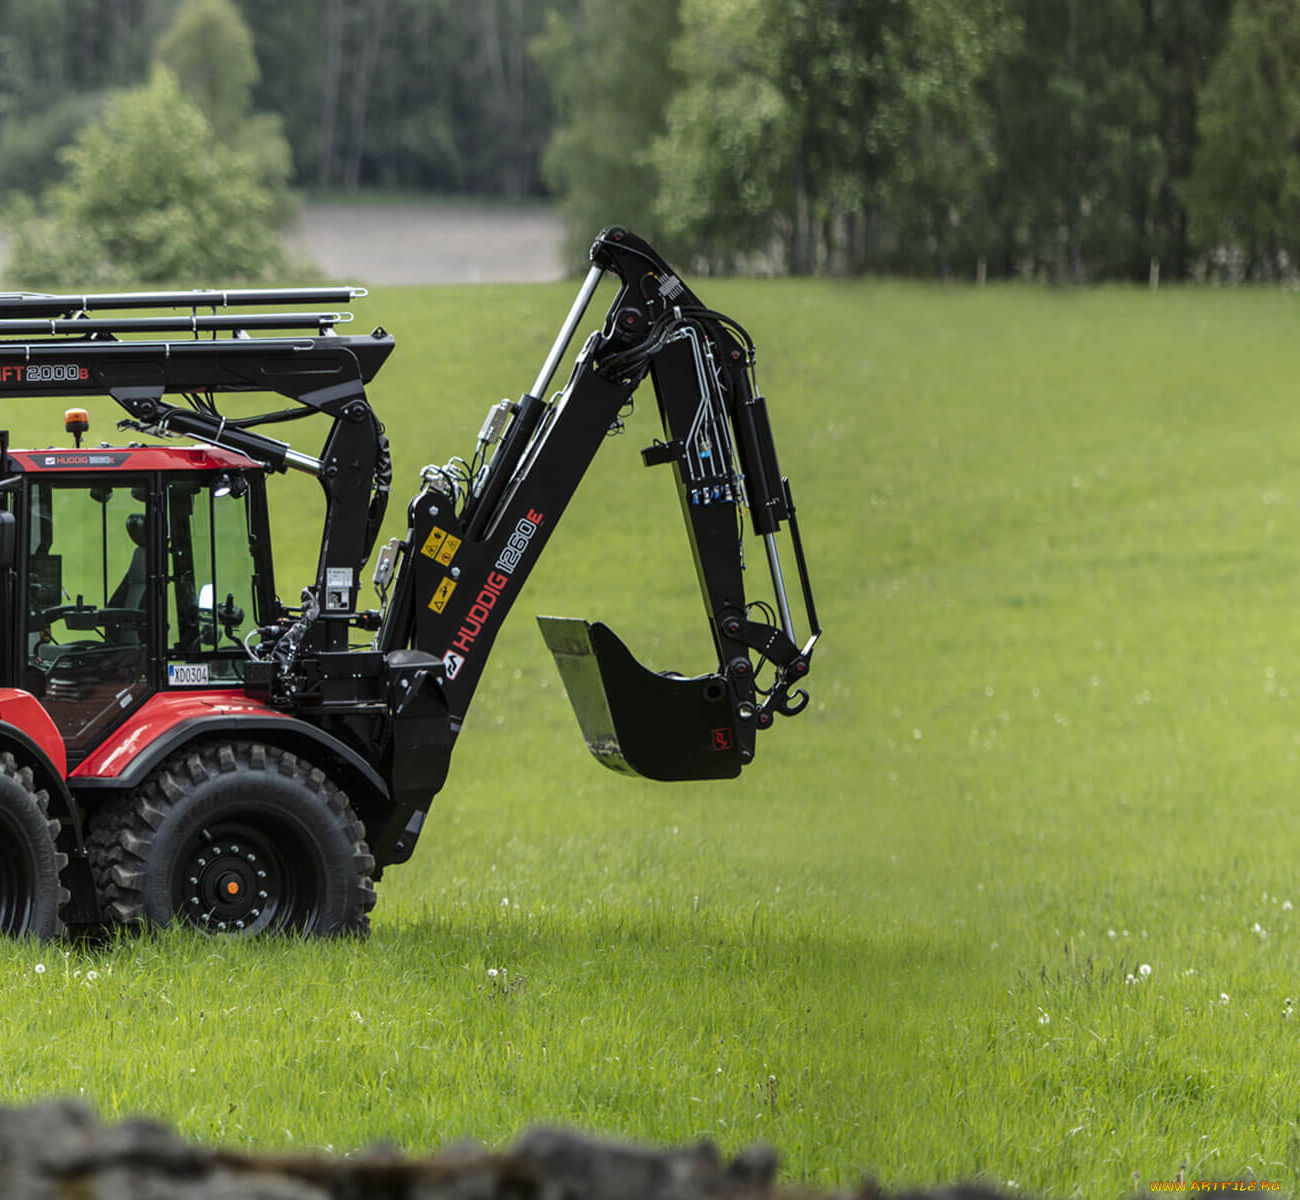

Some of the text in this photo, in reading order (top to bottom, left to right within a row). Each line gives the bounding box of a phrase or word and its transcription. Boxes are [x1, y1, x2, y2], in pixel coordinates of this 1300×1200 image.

[26, 364, 90, 382] 2000B
[452, 508, 543, 652] HUDDIG 1260E
